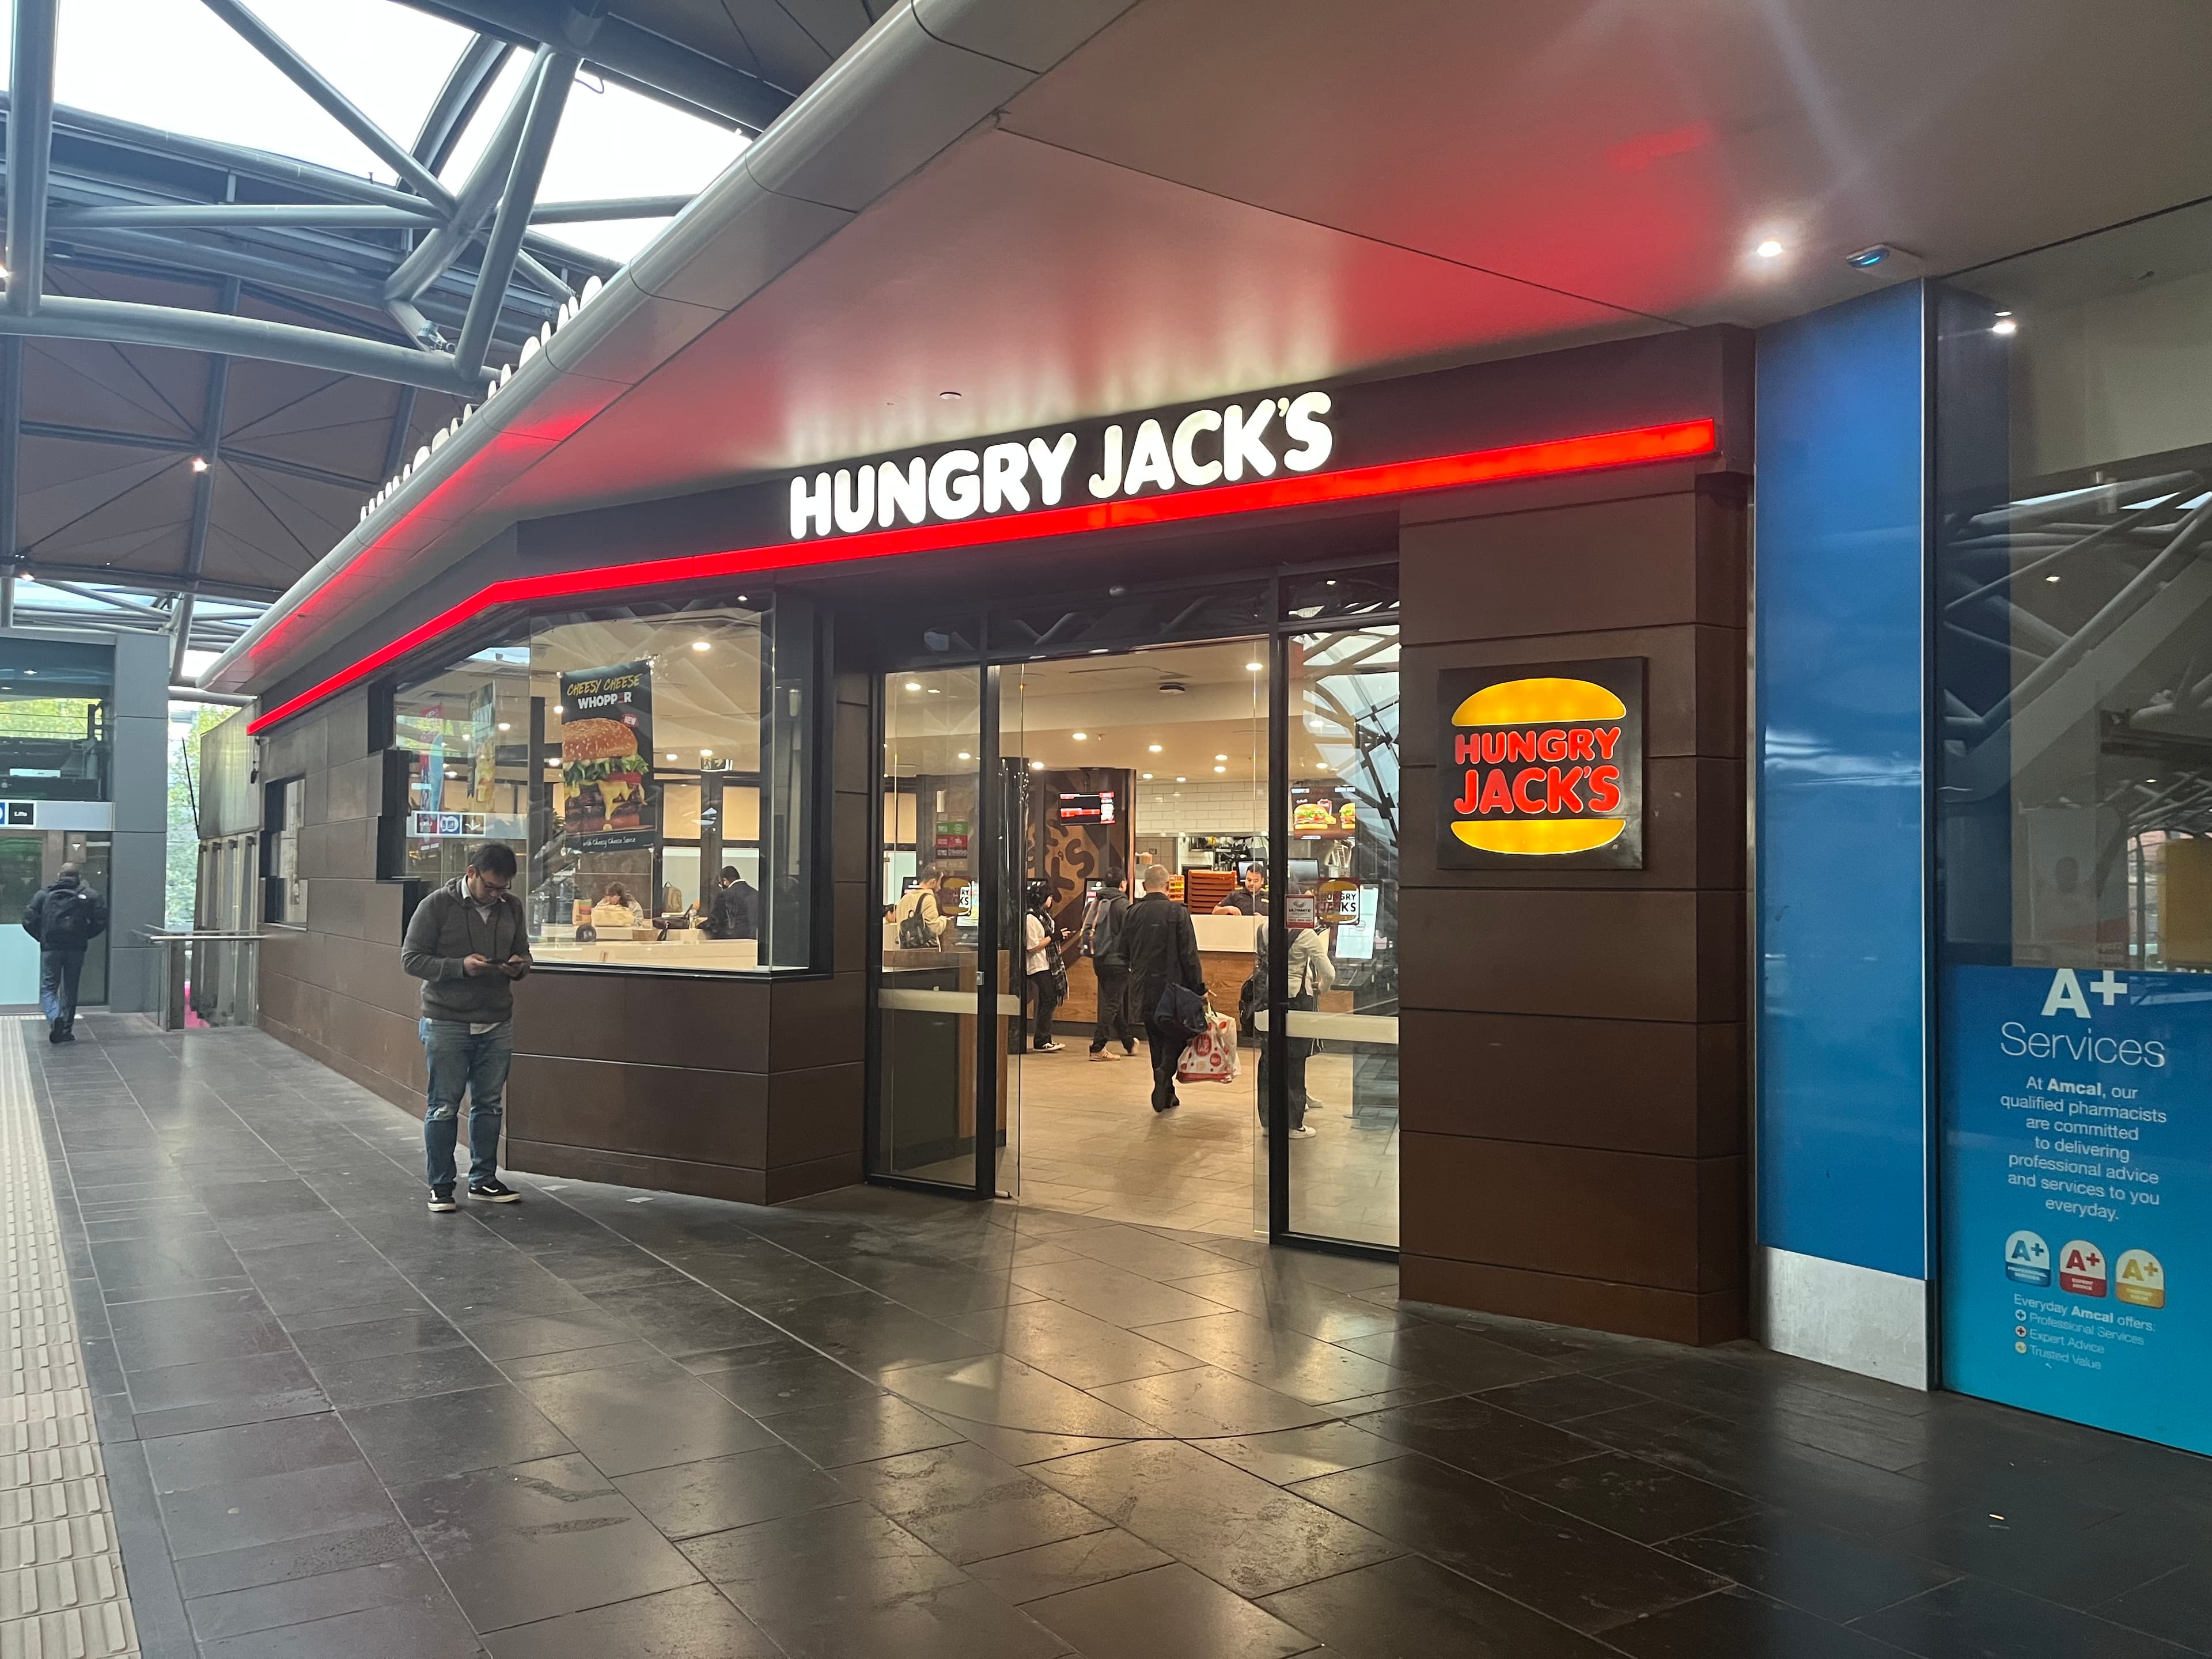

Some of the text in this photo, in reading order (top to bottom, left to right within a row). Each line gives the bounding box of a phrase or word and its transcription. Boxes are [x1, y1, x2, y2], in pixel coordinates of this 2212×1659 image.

[790, 391, 1334, 539] HUNGRY JACK'S
[567, 673, 643, 696] CHEESY CHEESE
[1455, 726, 1621, 765] HUNGRY
[1454, 765, 1621, 815] JACK'S
[2041, 968, 2128, 1018] A+
[2001, 1021, 2166, 1068] Services
[2026, 1076, 2138, 1099] At Amcal, our
[2000, 1095, 2167, 1123] qualified pharmacists
[2025, 1118, 2139, 1141] are committed
[2035, 1136, 2130, 1163] to delivering
[2009, 1154, 2159, 1184] professional advice
[2008, 1173, 2160, 1205] and services to you
[2045, 1199, 2119, 1222] everyday.
[2011, 1240, 2044, 1262] A+
[2066, 1249, 2100, 1271] A+
[2122, 1259, 2158, 1282] A+
[2014, 1293, 2068, 1316] Everyday
[2071, 1305, 2113, 1323] Amcal
[2029, 1312, 2145, 1346] Professional Services
[2029, 1328, 2105, 1354] Expert Advice
[2029, 1344, 2101, 1370] Trusted Value
